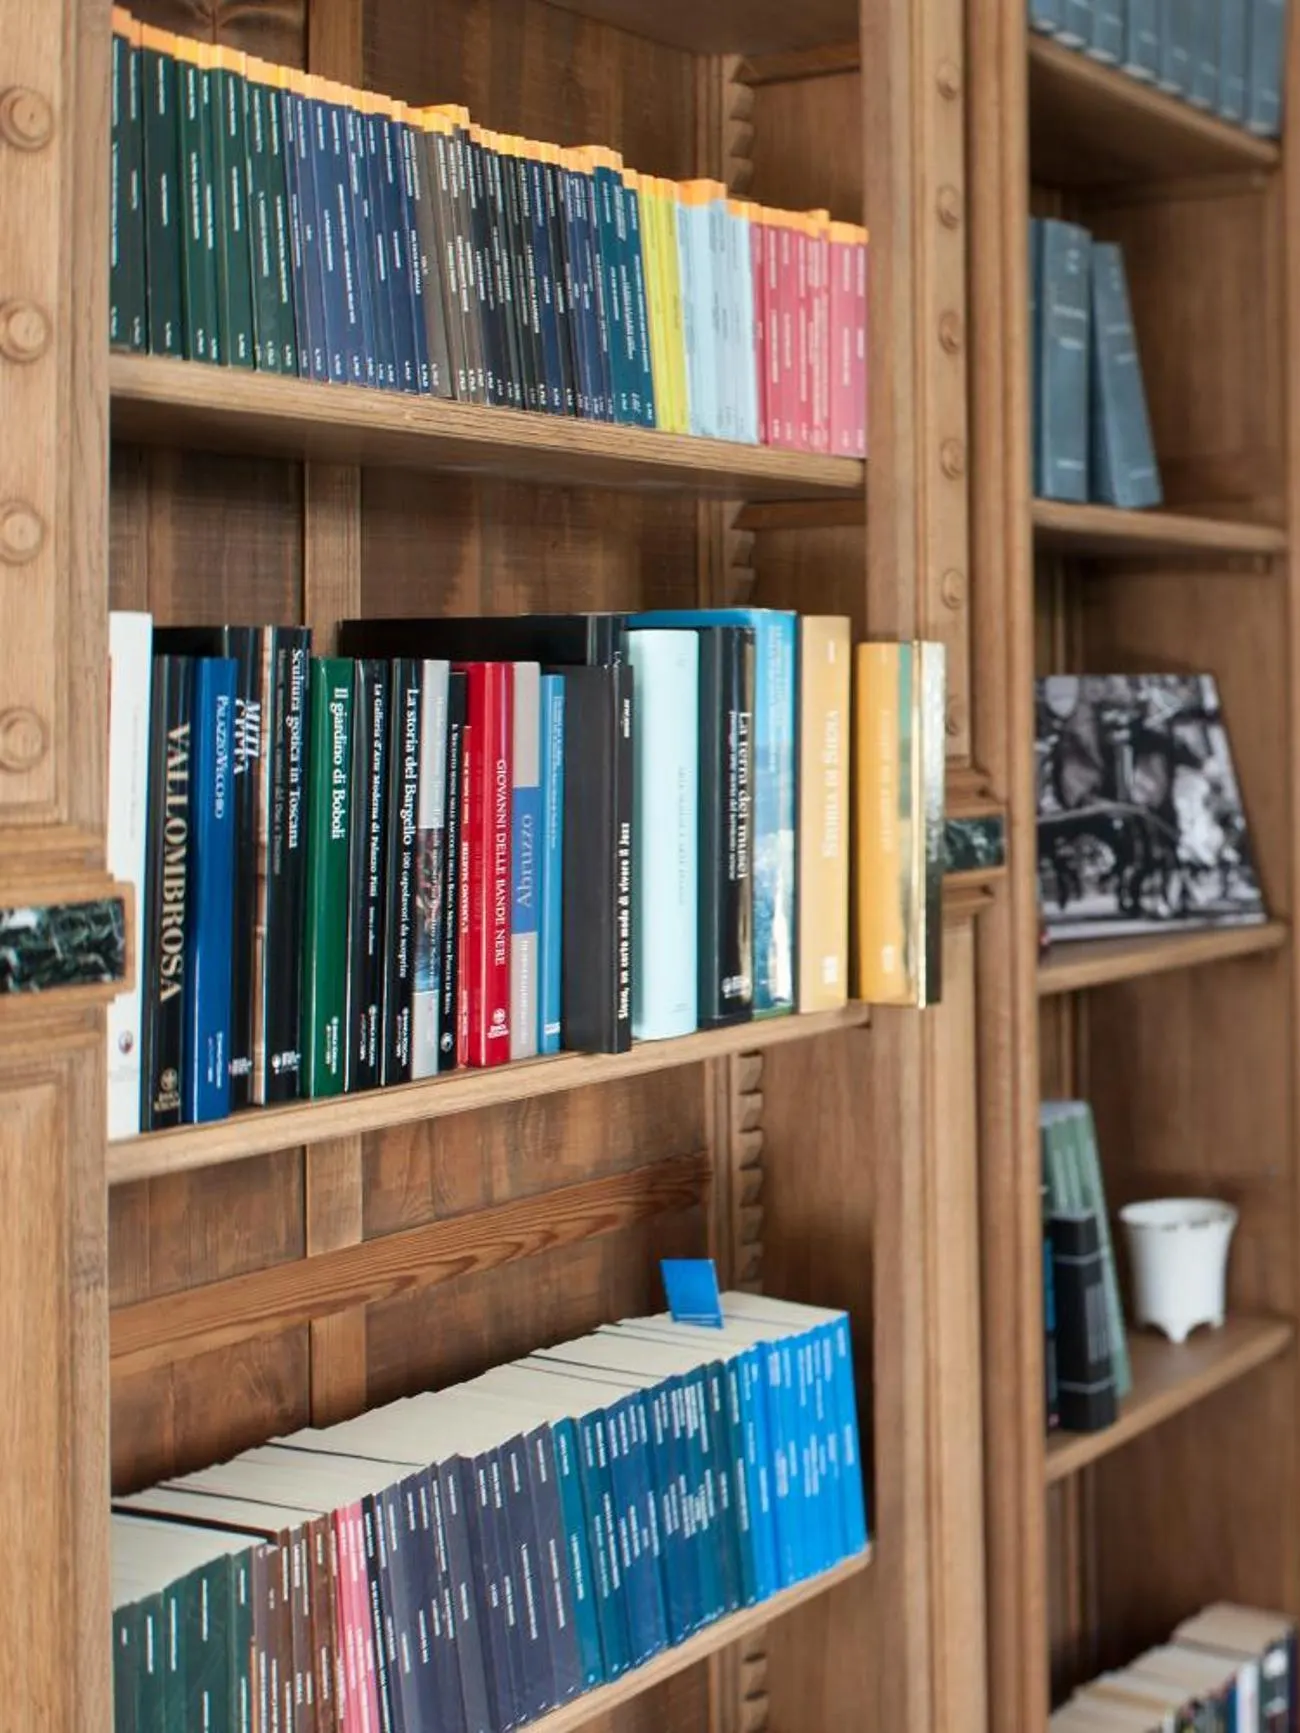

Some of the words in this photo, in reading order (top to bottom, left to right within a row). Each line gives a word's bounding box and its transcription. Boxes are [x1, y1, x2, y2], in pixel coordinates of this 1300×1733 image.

[290, 648, 304, 712] Scultura
[333, 687, 348, 699] Il
[405, 688, 419, 707] La
[286, 716, 302, 762] gotica
[329, 702, 348, 765] giardino
[373, 698, 383, 738] Galleria
[404, 709, 418, 753] storia
[738, 711, 752, 735] La
[289, 768, 302, 783] in
[332, 768, 346, 785] di
[404, 756, 418, 779] del
[737, 740, 750, 784] terra
[331, 789, 346, 839] Boboli
[371, 774, 381, 819] Moderna
[400, 783, 416, 846] Bargello
[495, 759, 507, 829] GIOVANNI
[737, 789, 752, 818] dei
[288, 786, 301, 849] Toscana
[371, 821, 380, 833] di
[159, 723, 191, 1003] VALLOMBROSA
[494, 832, 506, 875] DELLE
[516, 813, 534, 908] Abruzzo
[736, 825, 750, 879] musei
[399, 870, 412, 922] capolavori
[494, 878, 506, 927] BANDE
[494, 930, 505, 966] NERE
